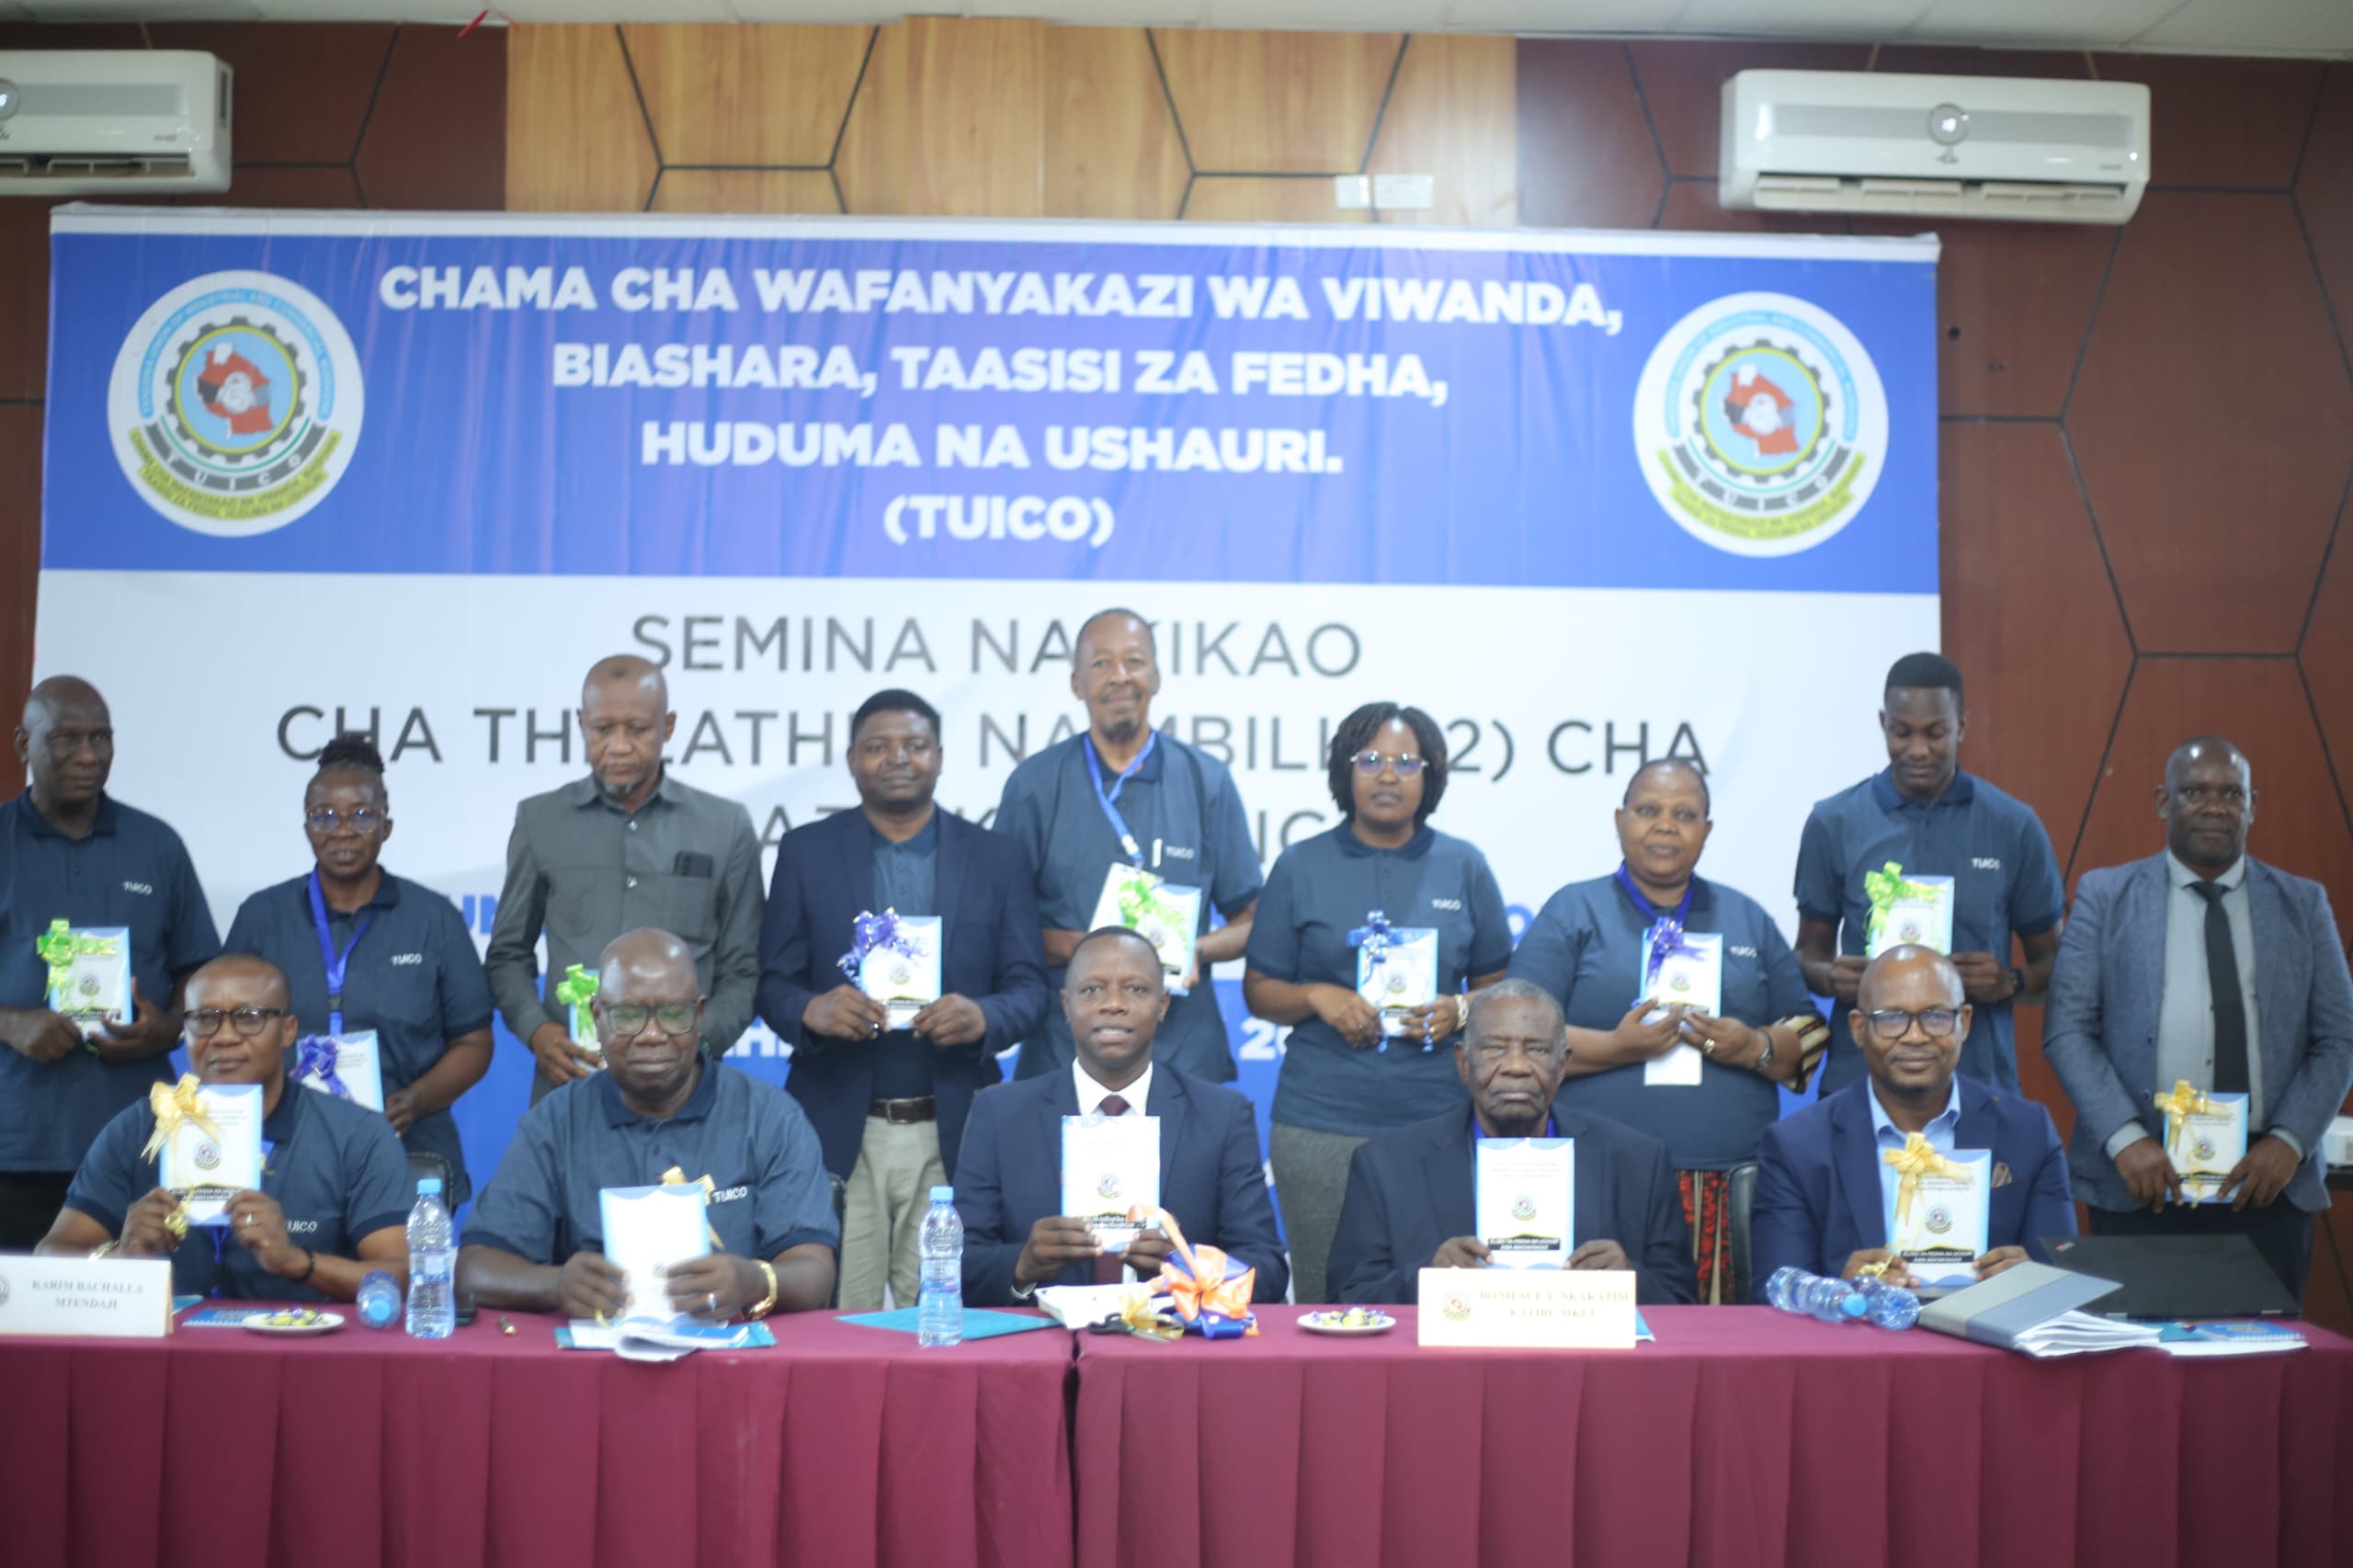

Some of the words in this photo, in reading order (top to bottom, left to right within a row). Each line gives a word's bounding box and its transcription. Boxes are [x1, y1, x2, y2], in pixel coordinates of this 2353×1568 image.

[380, 266, 597, 311] CHAMA
[610, 267, 738, 312] CHA
[753, 269, 1193, 318] WAFANYAKAZI
[1206, 276, 1310, 320] WA
[1322, 278, 1623, 336] VIWANDA,
[551, 343, 878, 398] BIASHARA,
[890, 346, 1121, 393] TAASISI
[1132, 350, 1220, 395] ZA
[1231, 352, 1449, 407] FEDHA,
[642, 421, 922, 467] HUDUMA
[936, 424, 1031, 469] NA
[1044, 426, 1344, 473] USHAURI.
[882, 494, 1116, 549] (TUICO)
[631, 615, 938, 673] SEMINA
[971, 619, 1075, 675] NA
[1149, 620, 1360, 677] IKAO
[277, 705, 442, 763] CHA
[1547, 721, 1710, 775] CHA
[711, 1186, 748, 1204] TUICO
